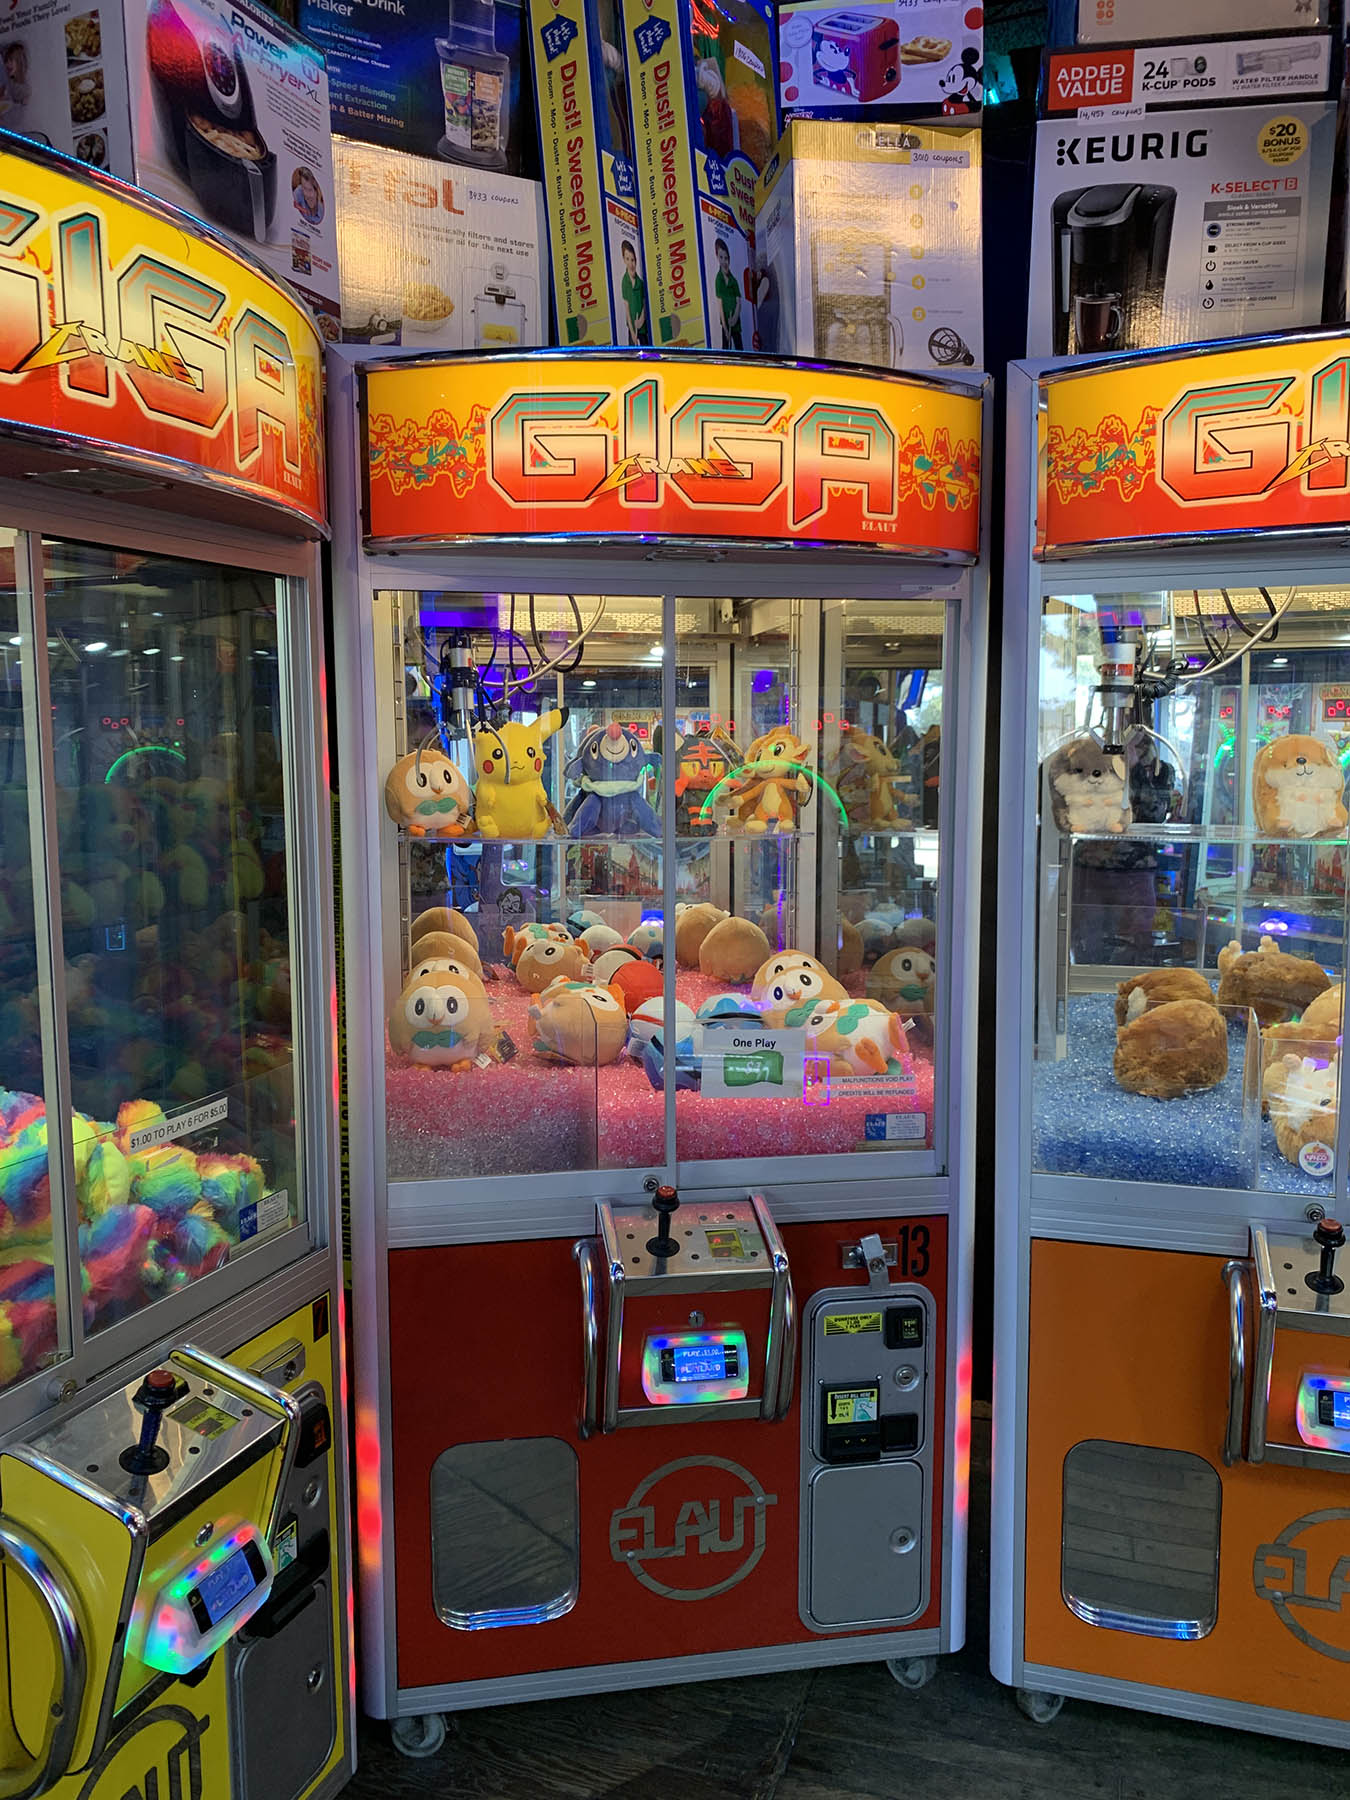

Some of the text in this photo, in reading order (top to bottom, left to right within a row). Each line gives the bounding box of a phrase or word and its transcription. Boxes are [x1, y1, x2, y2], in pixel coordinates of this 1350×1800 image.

[231, 10, 288, 59] Power
[1057, 63, 1126, 82] ADDED
[1143, 61, 1169, 80] 24
[328, 78, 396, 101] -Speed Blending
[1057, 78, 1124, 98] VALUE
[1141, 77, 1216, 92] K-CUP PODS
[306, 85, 322, 105] XL
[345, 94, 388, 111] Extraction
[348, 107, 374, 120] Batter
[376, 114, 405, 128] Mixing
[1269, 123, 1297, 137] $20
[872, 135, 911, 148] ELLA
[1057, 129, 1209, 166] KEURIG
[1263, 137, 1302, 148] BONUS
[932, 154, 964, 165] coupons
[561, 60, 598, 309] Dust! Sweep! Mop!
[654, 60, 691, 308] Dust! Sweep! Mop!
[730, 180, 756, 208] Swee
[1211, 180, 1279, 194] K-SELECT
[555, 175, 563, 200] Brush
[559, 209, 567, 245] Dustpan
[1251, 202, 1278, 210] Versatile
[652, 209, 660, 245] Dustpan
[468, 230, 491, 242] filters
[494, 235, 507, 245] and
[510, 238, 535, 249] stores
[497, 244, 514, 255] next
[516, 248, 529, 257] use
[490, 379, 897, 527] GIGA
[862, 520, 898, 534] ELAUT
[733, 1038, 777, 1050] One Play
[131, 1132, 152, 1148] $1.00
[153, 1129, 165, 1139] TO
[166, 1121, 188, 1135] PLAY
[193, 1111, 209, 1124] FOR
[210, 1103, 227, 1118] $5.00
[900, 1225, 930, 1277] 13
[610, 1494, 778, 1562] ELAUT
